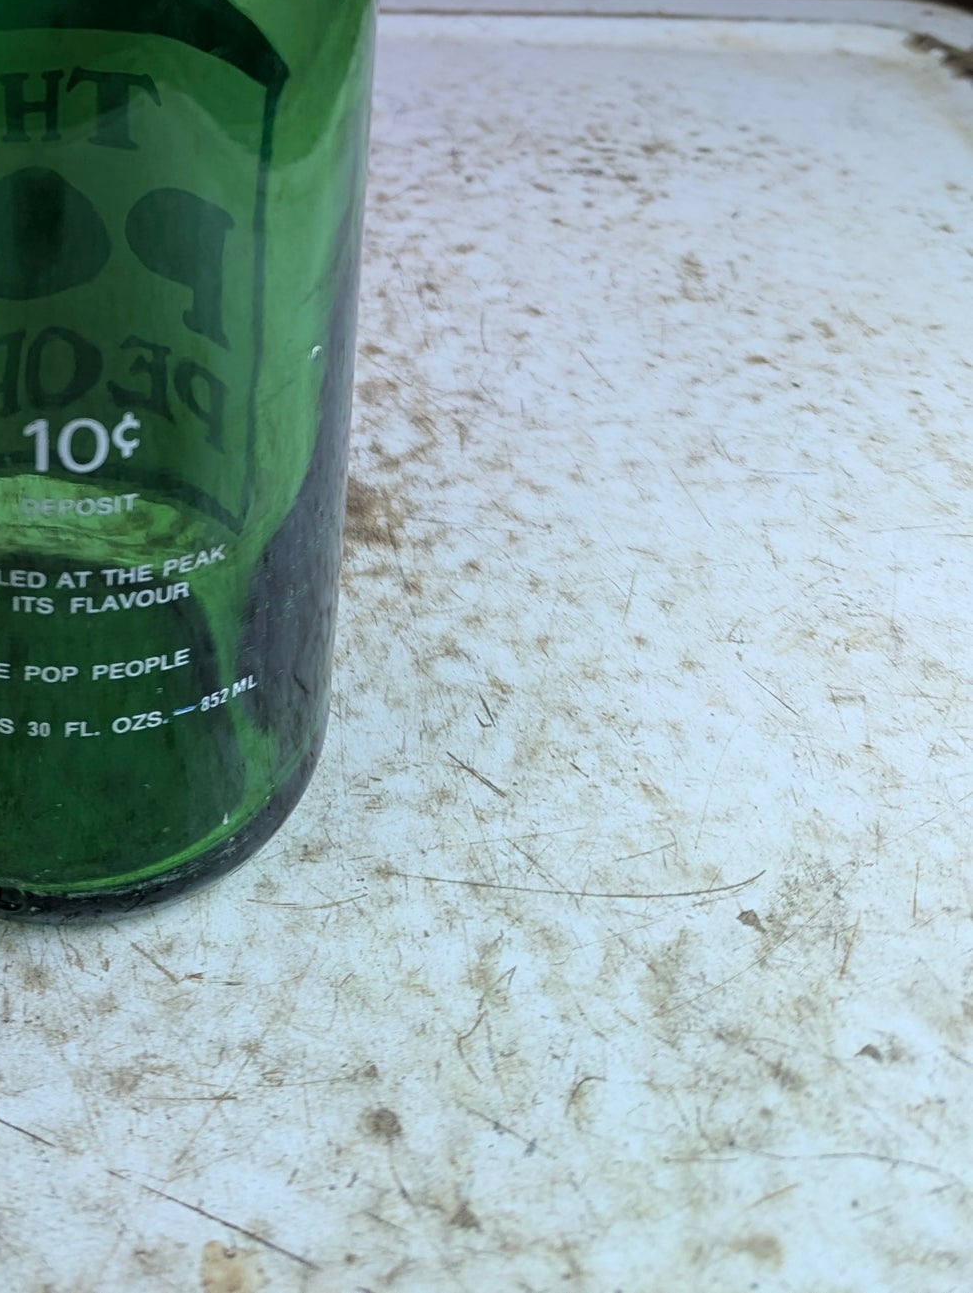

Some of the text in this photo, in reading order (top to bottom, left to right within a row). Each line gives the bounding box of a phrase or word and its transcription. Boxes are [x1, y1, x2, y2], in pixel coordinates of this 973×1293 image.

[21, 493, 140, 518] DEPOSIT
[55, 570, 93, 589] AT
[103, 564, 154, 587] THE
[161, 543, 227, 578] PEAK
[12, 595, 55, 615] ITS
[69, 581, 191, 614] FLAVOUR
[24, 664, 79, 683] POP
[91, 647, 191, 681] PEOPLE
[27, 721, 51, 738] 30
[64, 720, 101, 738] FL.
[112, 709, 169, 735] OZS.
[231, 674, 258, 700] ML
